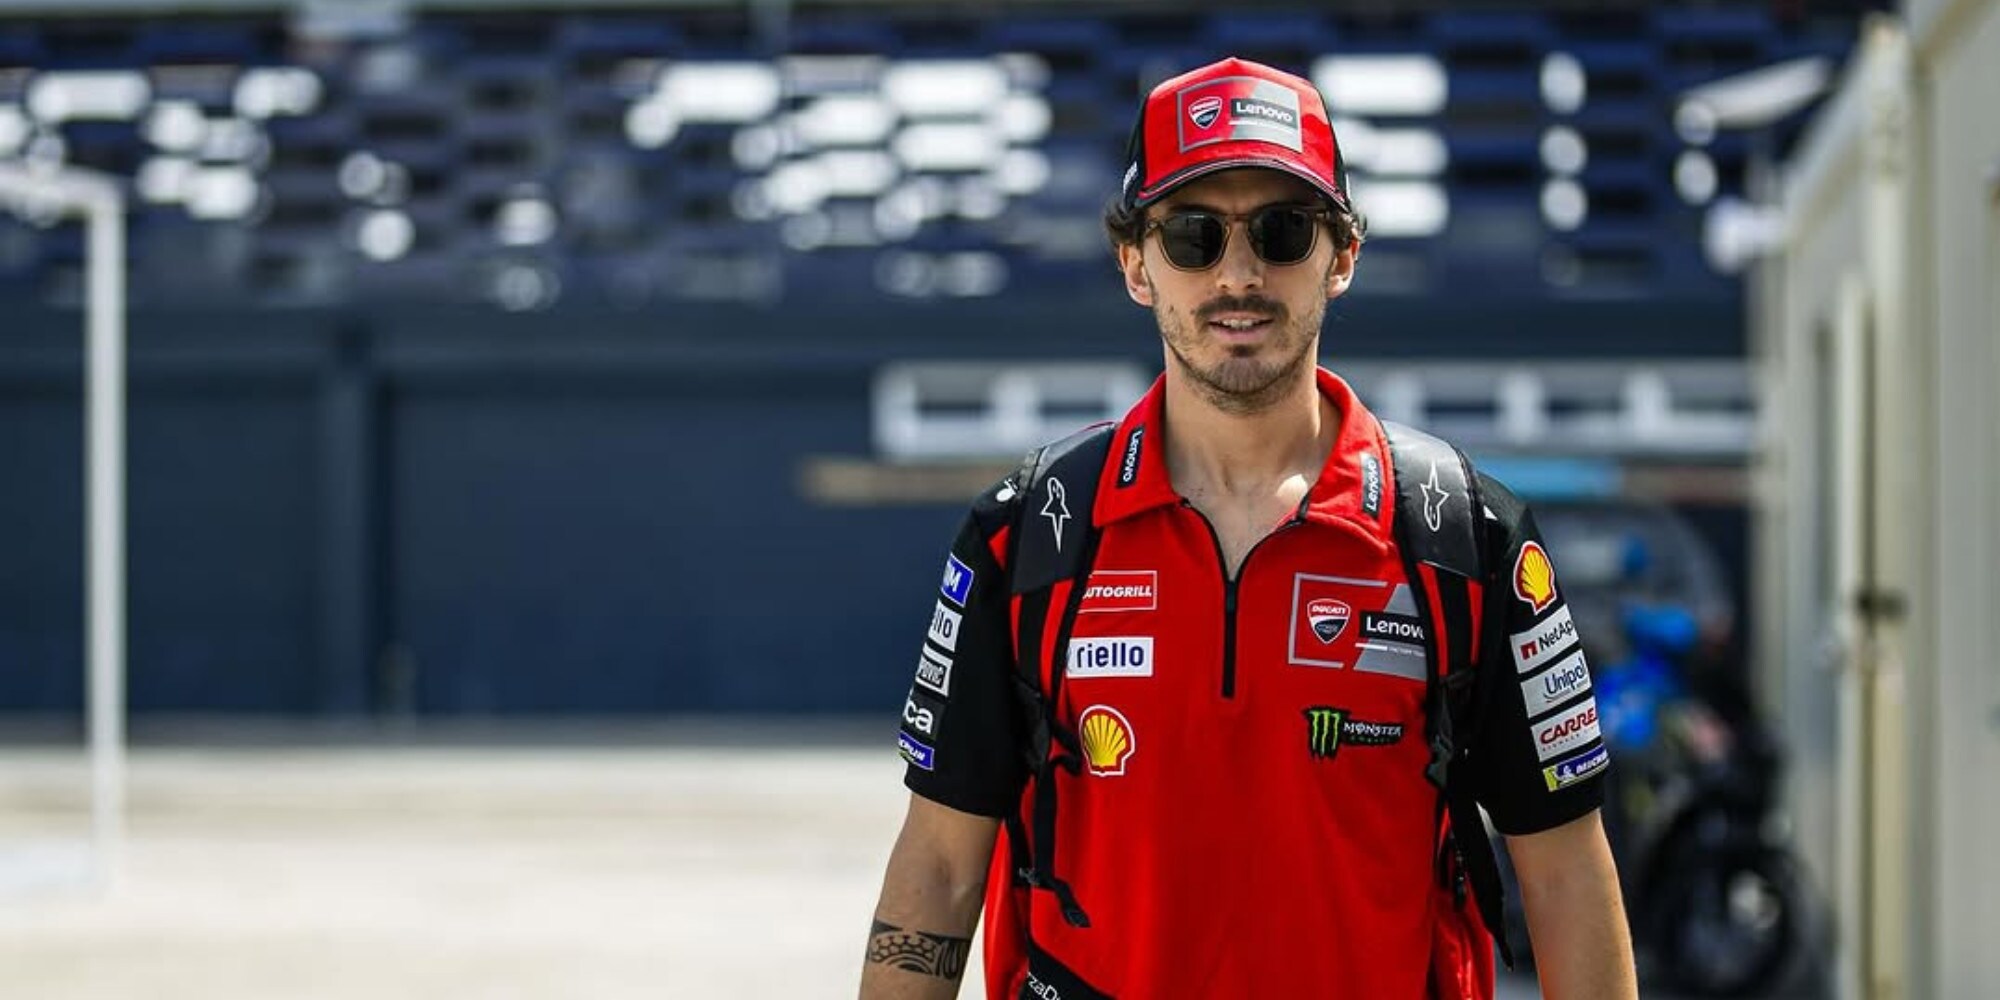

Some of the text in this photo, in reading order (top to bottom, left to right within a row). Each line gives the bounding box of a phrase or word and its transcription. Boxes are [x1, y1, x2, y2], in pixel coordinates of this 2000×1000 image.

[1235, 101, 1293, 122] Lenovo
[1122, 430, 1143, 483] Lenovo
[1366, 459, 1380, 512] Lenovo
[1366, 615, 1425, 640] Lenov
[1538, 619, 1575, 651] NetAp
[1076, 642, 1145, 668] riello
[903, 699, 934, 734] ca
[1343, 721, 1402, 737] MONSTER
[1540, 707, 1598, 745] CARRE
